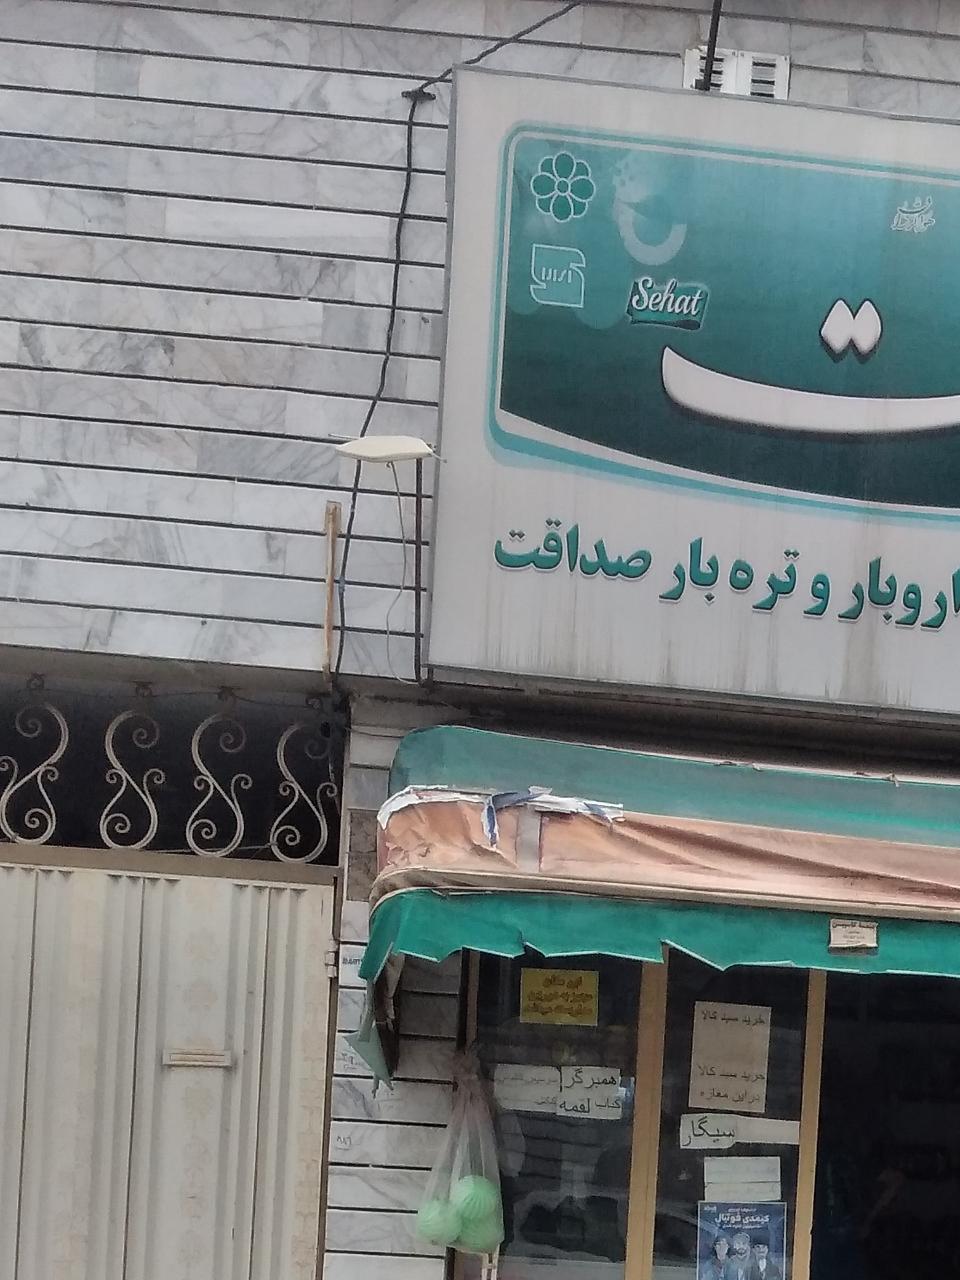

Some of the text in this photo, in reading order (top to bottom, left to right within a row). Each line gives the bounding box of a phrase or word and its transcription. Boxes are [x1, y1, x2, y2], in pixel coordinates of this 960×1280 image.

[631, 277, 704, 316] Sehat
[494, 518, 652, 579] صداقت
[701, 1009, 718, 1021] کالا
[742, 1013, 765, 1026] خرید
[697, 1063, 716, 1077] کالا
[682, 1116, 736, 1147] سیگار
